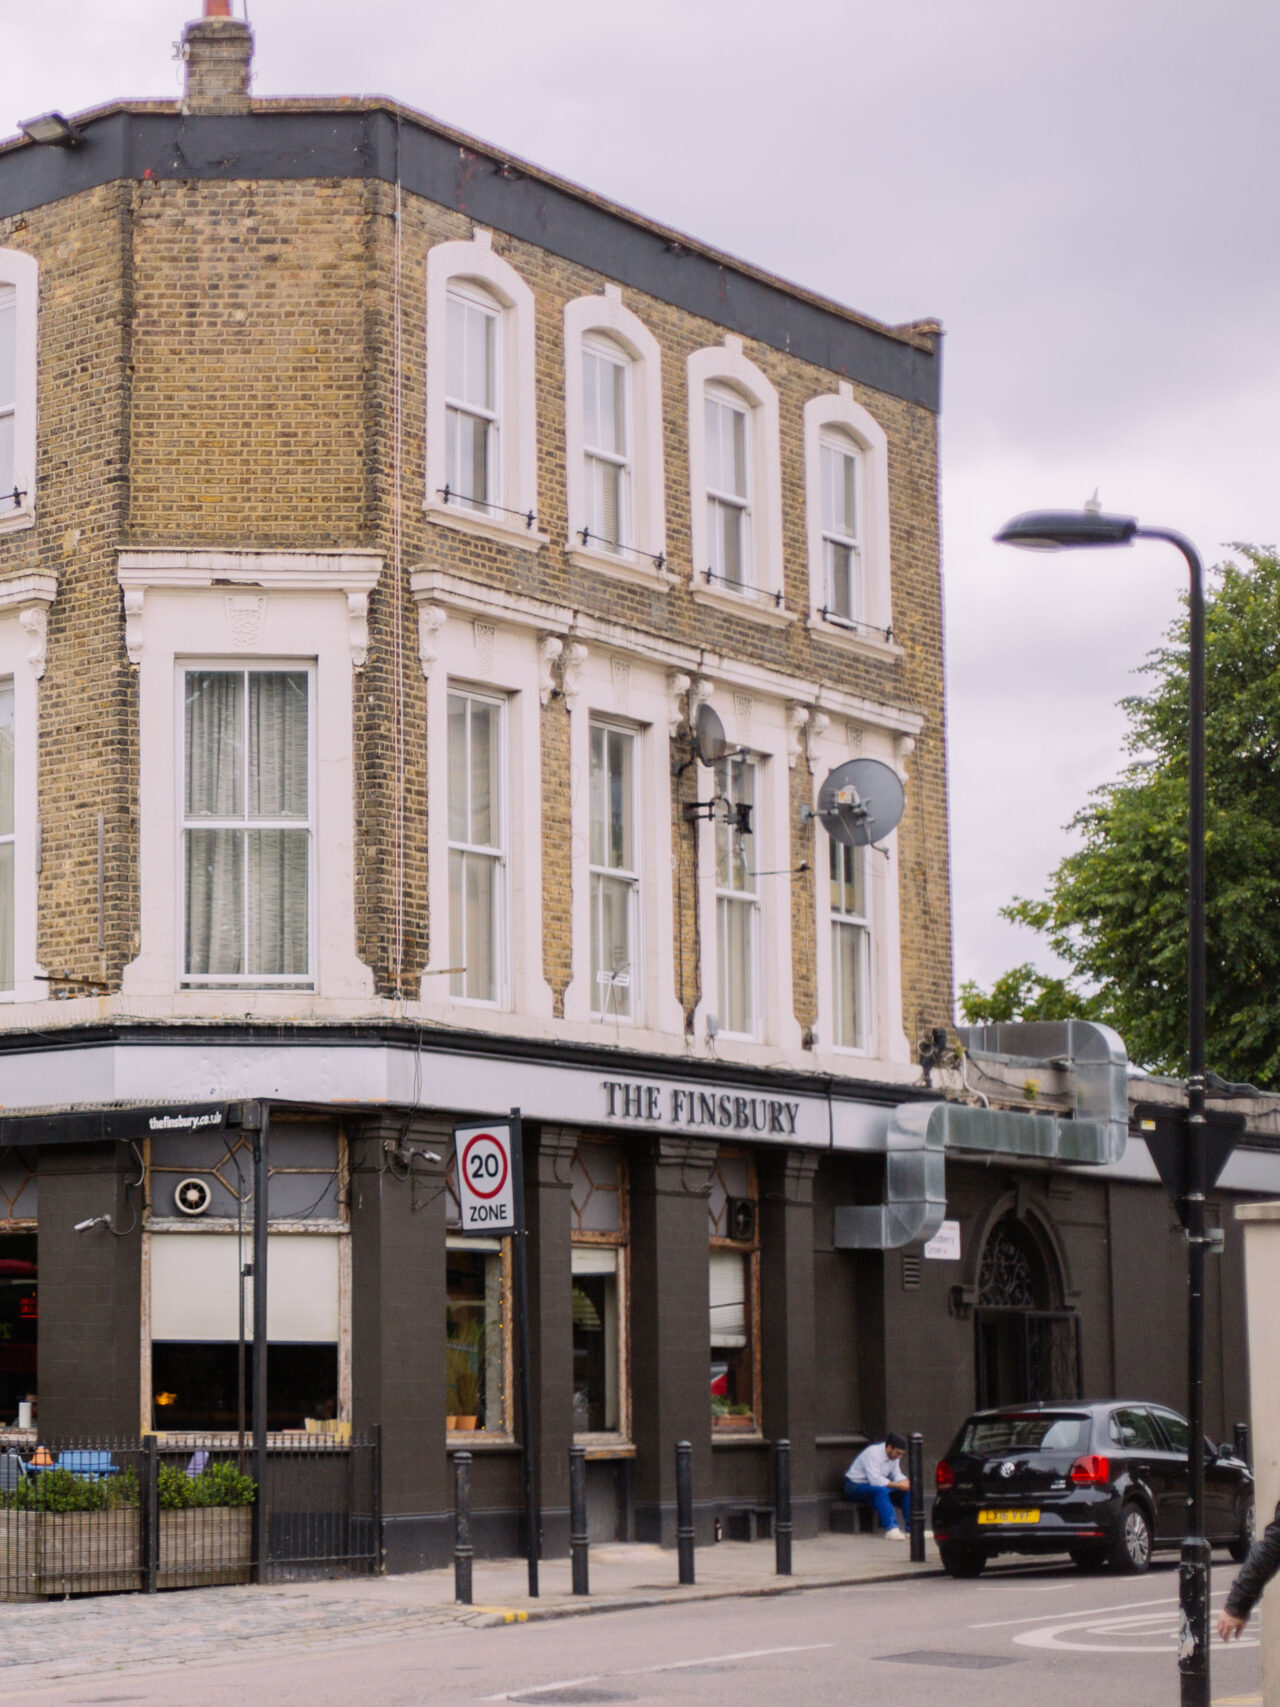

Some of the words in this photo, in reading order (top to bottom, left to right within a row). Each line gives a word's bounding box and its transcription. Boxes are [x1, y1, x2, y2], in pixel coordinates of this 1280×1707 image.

[602, 1081, 662, 1121] THE
[672, 1088, 800, 1135] FINSBURY
[149, 1110, 222, 1130] thefinsbury.co.uk
[470, 1153, 499, 1179] 20
[469, 1204, 508, 1222] ZONE
